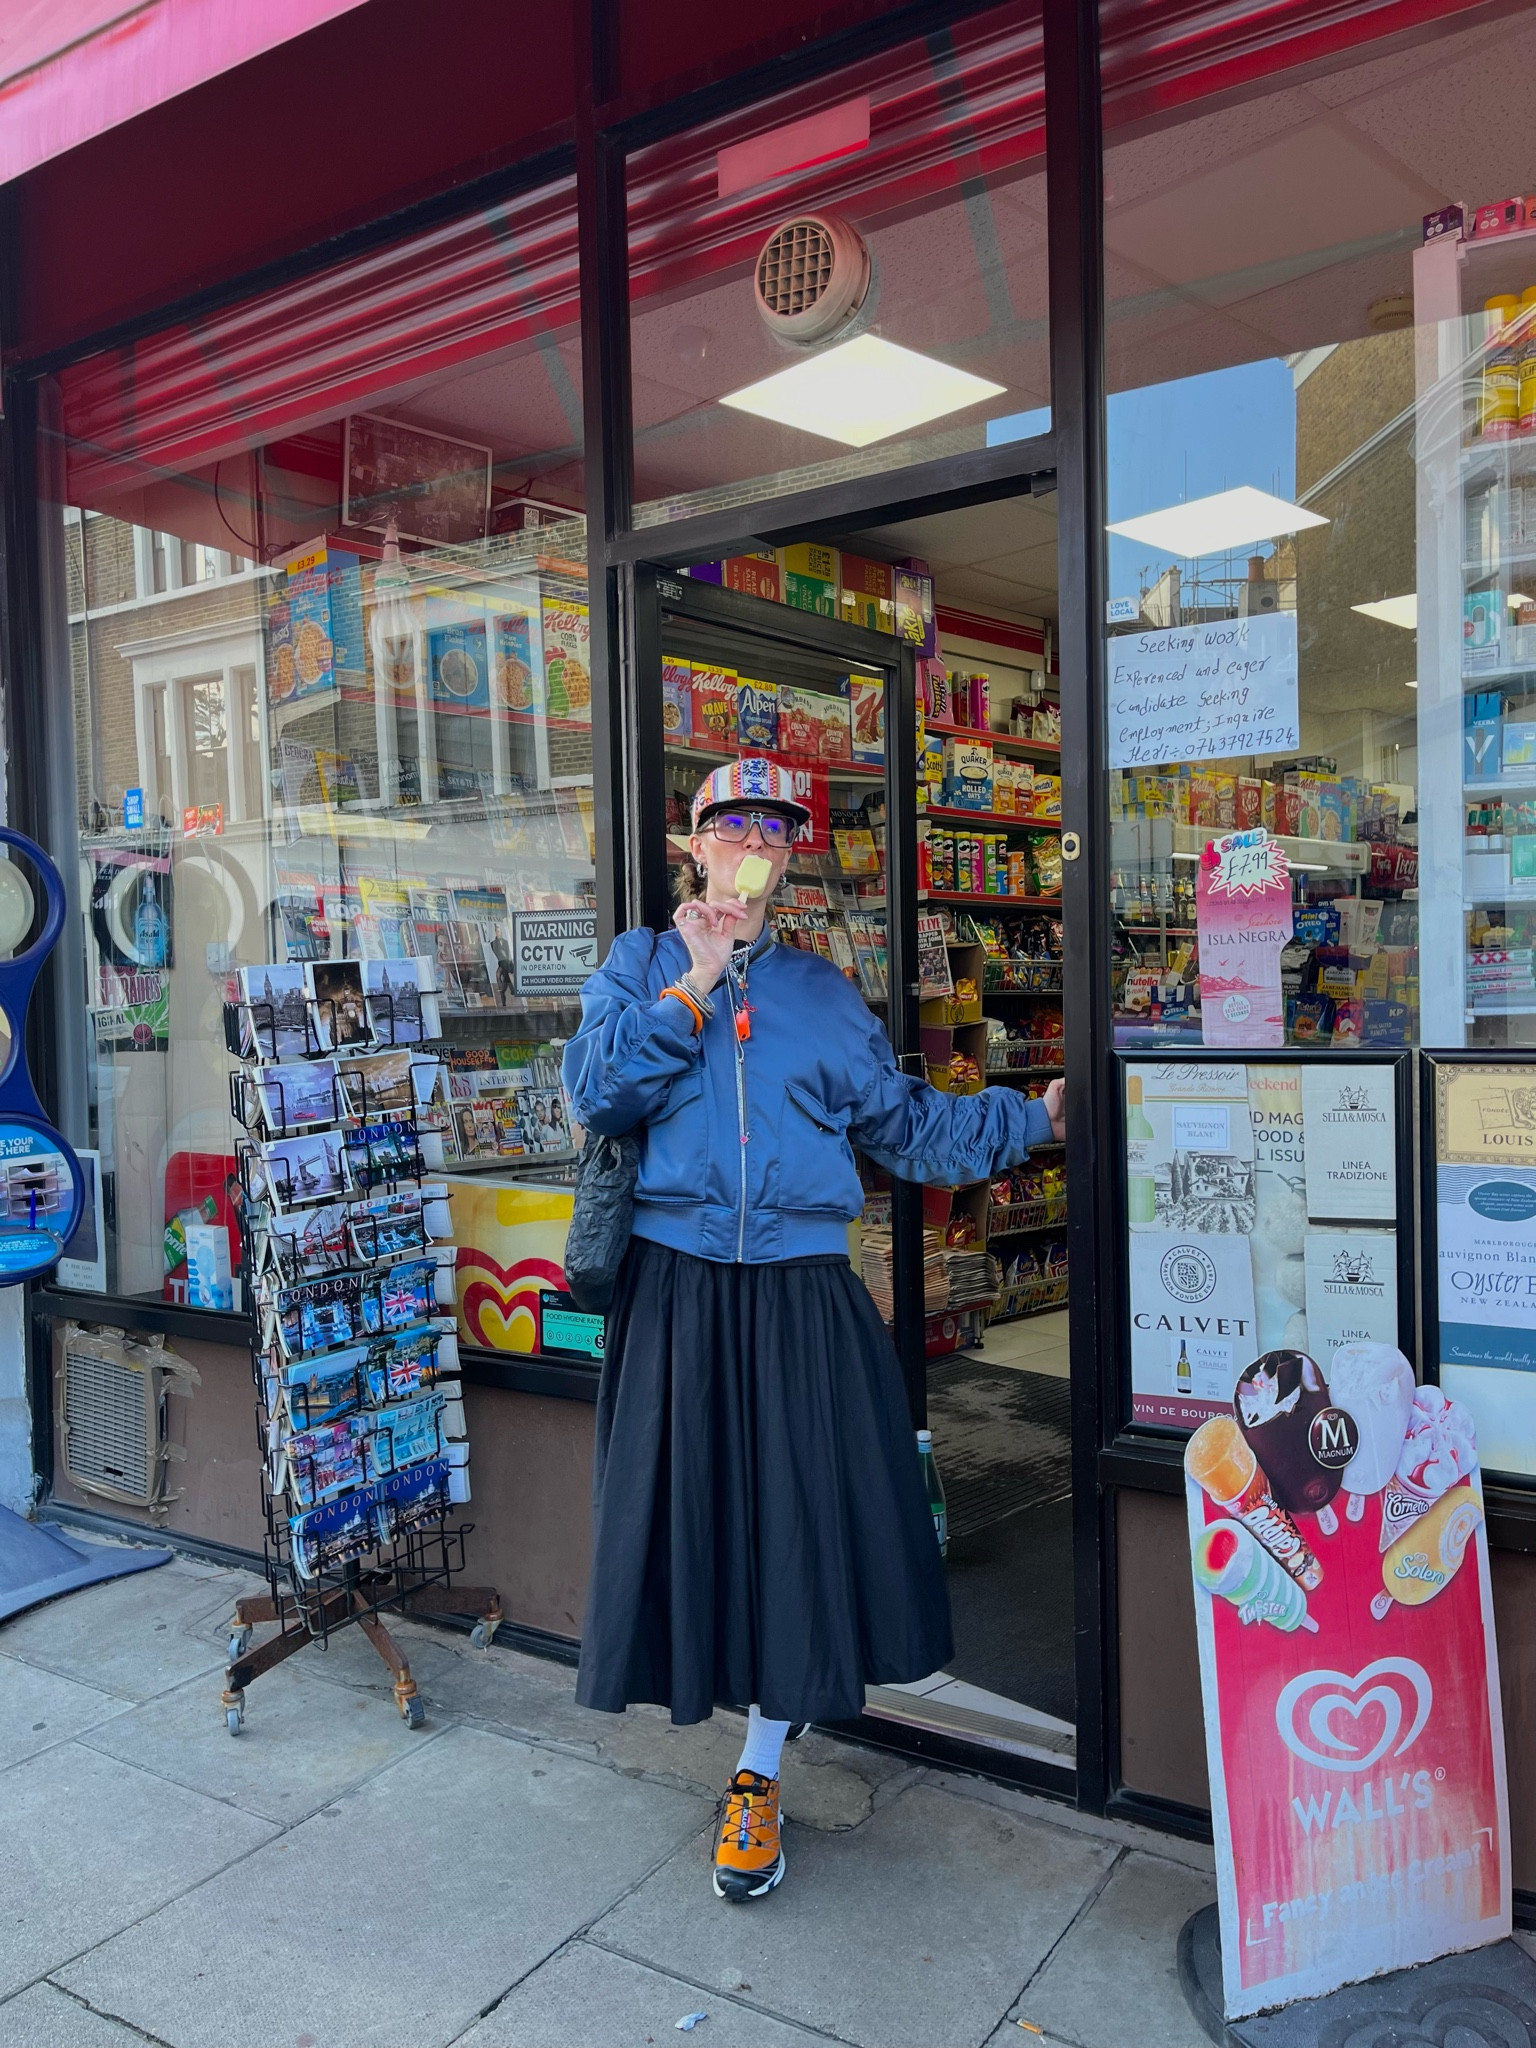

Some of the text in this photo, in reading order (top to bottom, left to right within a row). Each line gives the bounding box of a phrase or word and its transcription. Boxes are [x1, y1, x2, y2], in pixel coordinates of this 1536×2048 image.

[297, 556, 315, 570] £3.29
[1110, 600, 1130, 609] LOVE
[1110, 607, 1135, 617] LOCAL
[1137, 635, 1194, 654] Seeking
[1196, 658, 1220, 677] and
[1226, 656, 1272, 680] eager
[754, 680, 773, 692] £2.89
[740, 688, 776, 716] Alpen
[1117, 692, 1188, 716] Candidate
[702, 702, 728, 716] KRAVE
[960, 755, 988, 766] QUAKER
[962, 784, 986, 794] ROLLED
[127, 796, 138, 805] SHOP
[967, 792, 981, 800] OATS
[127, 804, 140, 815] SMALL
[830, 810, 866, 818] MONOCLE
[128, 814, 140, 824] HERE
[1220, 830, 1264, 853] SALE
[1226, 851, 1268, 881] £7.99
[852, 914, 876, 924] nature
[926, 917, 940, 931] EYE
[139, 930, 160, 938] Asahi
[523, 921, 595, 938] WARNING
[1208, 930, 1287, 946] ISLA NEGRA
[521, 946, 564, 962] CCTV
[529, 963, 566, 971] OPERATION
[1127, 977, 1159, 986] nutella
[1389, 1008, 1404, 1017] KP
[465, 1050, 490, 1058] GOOD
[1152, 1063, 1240, 1082] Le Pressoir
[480, 1074, 529, 1086] INTERIORS
[1322, 1112, 1386, 1123] SELLA&MOSCA
[1176, 1122, 1225, 1130] SAUVIGNON
[8, 1136, 34, 1146] YOUR
[1482, 1134, 1533, 1146] LOUIS
[6, 1145, 30, 1154] HERE
[1342, 1161, 1371, 1170] LINEA
[1327, 1171, 1388, 1181] TRADIZIONE
[164, 1228, 187, 1256] Sprite
[1172, 1248, 1201, 1257] CALVET
[1163, 1263, 1174, 1291] MAISON
[1451, 1270, 1523, 1296] Oyster
[1324, 1285, 1384, 1296] SELLA&MOSCA
[1460, 1297, 1487, 1305] NEW
[546, 1313, 586, 1324] FOOD HYGIENE
[1134, 1313, 1249, 1336] CALVET
[1342, 1330, 1371, 1339] LINEA
[597, 1336, 603, 1347] 5
[1196, 1348, 1228, 1357] CALVET
[1449, 1346, 1530, 1366] Sometimes the world really
[1134, 1404, 1154, 1414] VIN
[1159, 1406, 1176, 1416] DE
[1318, 1447, 1354, 1459] MAGNUM
[384, 1461, 449, 1496] LONDON
[304, 1491, 374, 1530] LONDON
[1386, 1492, 1429, 1522] Cornetto
[1395, 1555, 1445, 1586] Solero
[1292, 1770, 1432, 1836] WALL'S
[1262, 1888, 1334, 1929] Fancy
